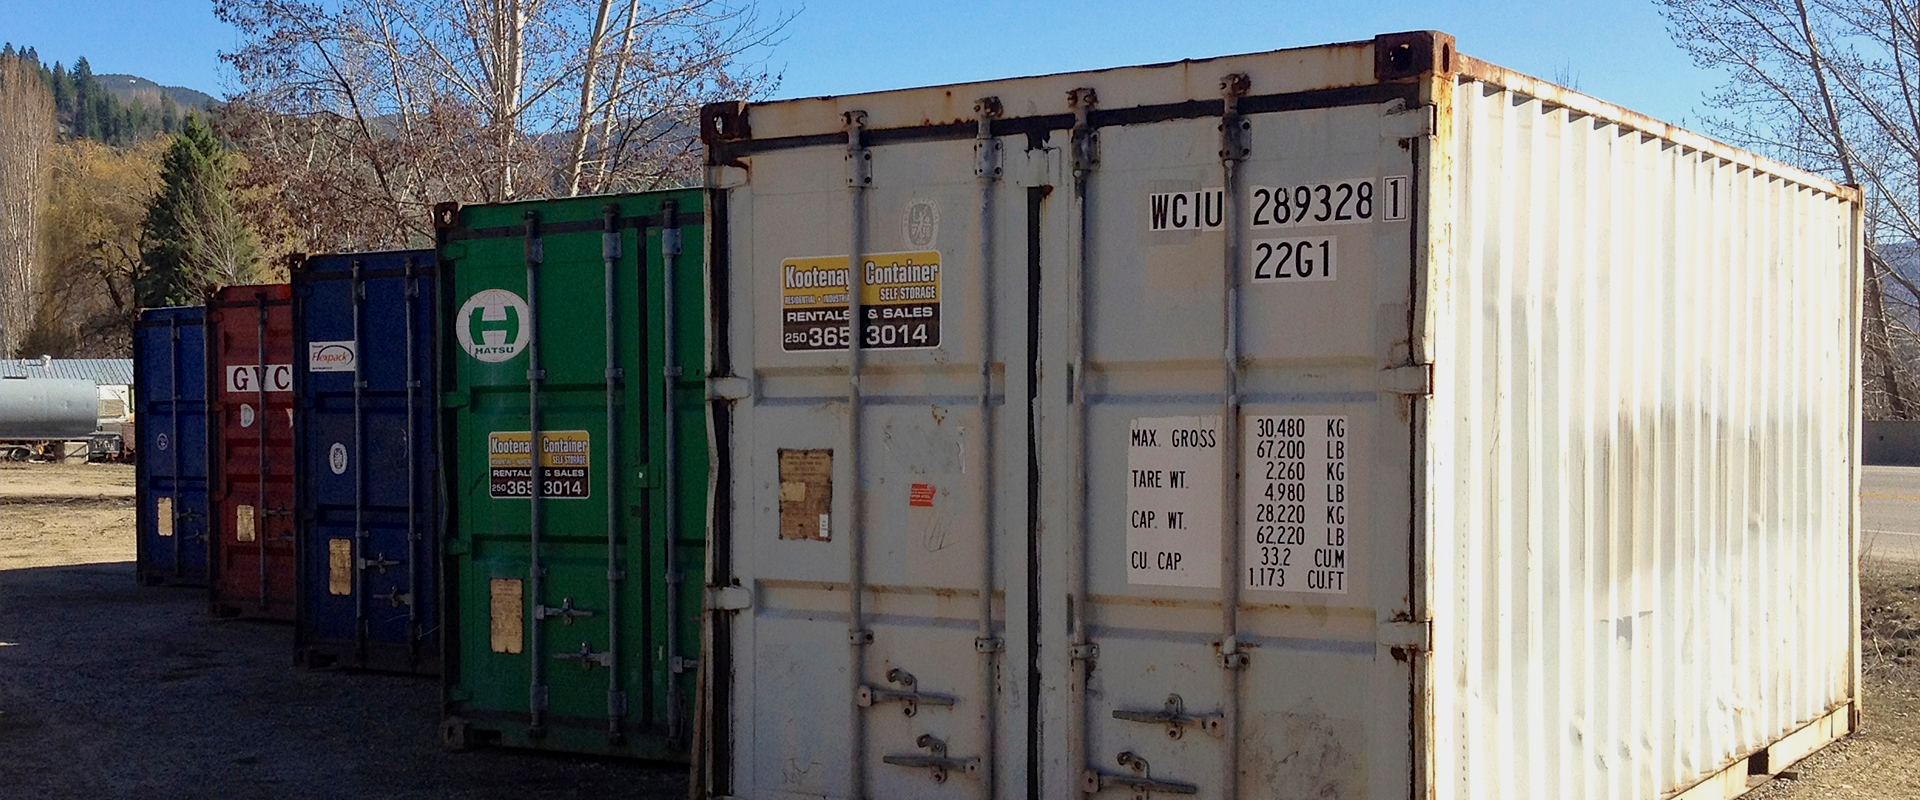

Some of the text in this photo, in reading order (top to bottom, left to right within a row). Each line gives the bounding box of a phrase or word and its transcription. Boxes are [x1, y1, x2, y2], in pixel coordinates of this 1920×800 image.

[1151, 190, 1222, 229] WCIU
[1253, 181, 1373, 226] 289328
[1254, 239, 1330, 279] 22G1
[865, 259, 938, 285] Container
[880, 285, 936, 301] SELF STORAGE
[787, 306, 933, 322] RENTALS & SALES
[785, 323, 928, 347] 250 365 3014
[475, 346, 514, 355] HATSU
[1327, 418, 1345, 438] KG
[543, 436, 588, 453] Container
[1172, 429, 1216, 448] GROSS
[1327, 440, 1344, 460] LB
[545, 469, 551, 477] &
[554, 468, 584, 477] SALES
[1132, 470, 1189, 489] TARE WT.
[1327, 462, 1345, 481] KG
[543, 480, 582, 495] 3014
[1327, 484, 1344, 503] LB
[1132, 510, 1187, 530] CAP. WT.
[1327, 505, 1345, 525] KG
[1327, 527, 1344, 546] LB
[1158, 552, 1184, 571] CAP.
[1261, 546, 1291, 566] 33.2
[1307, 569, 1345, 590] CU.FT
